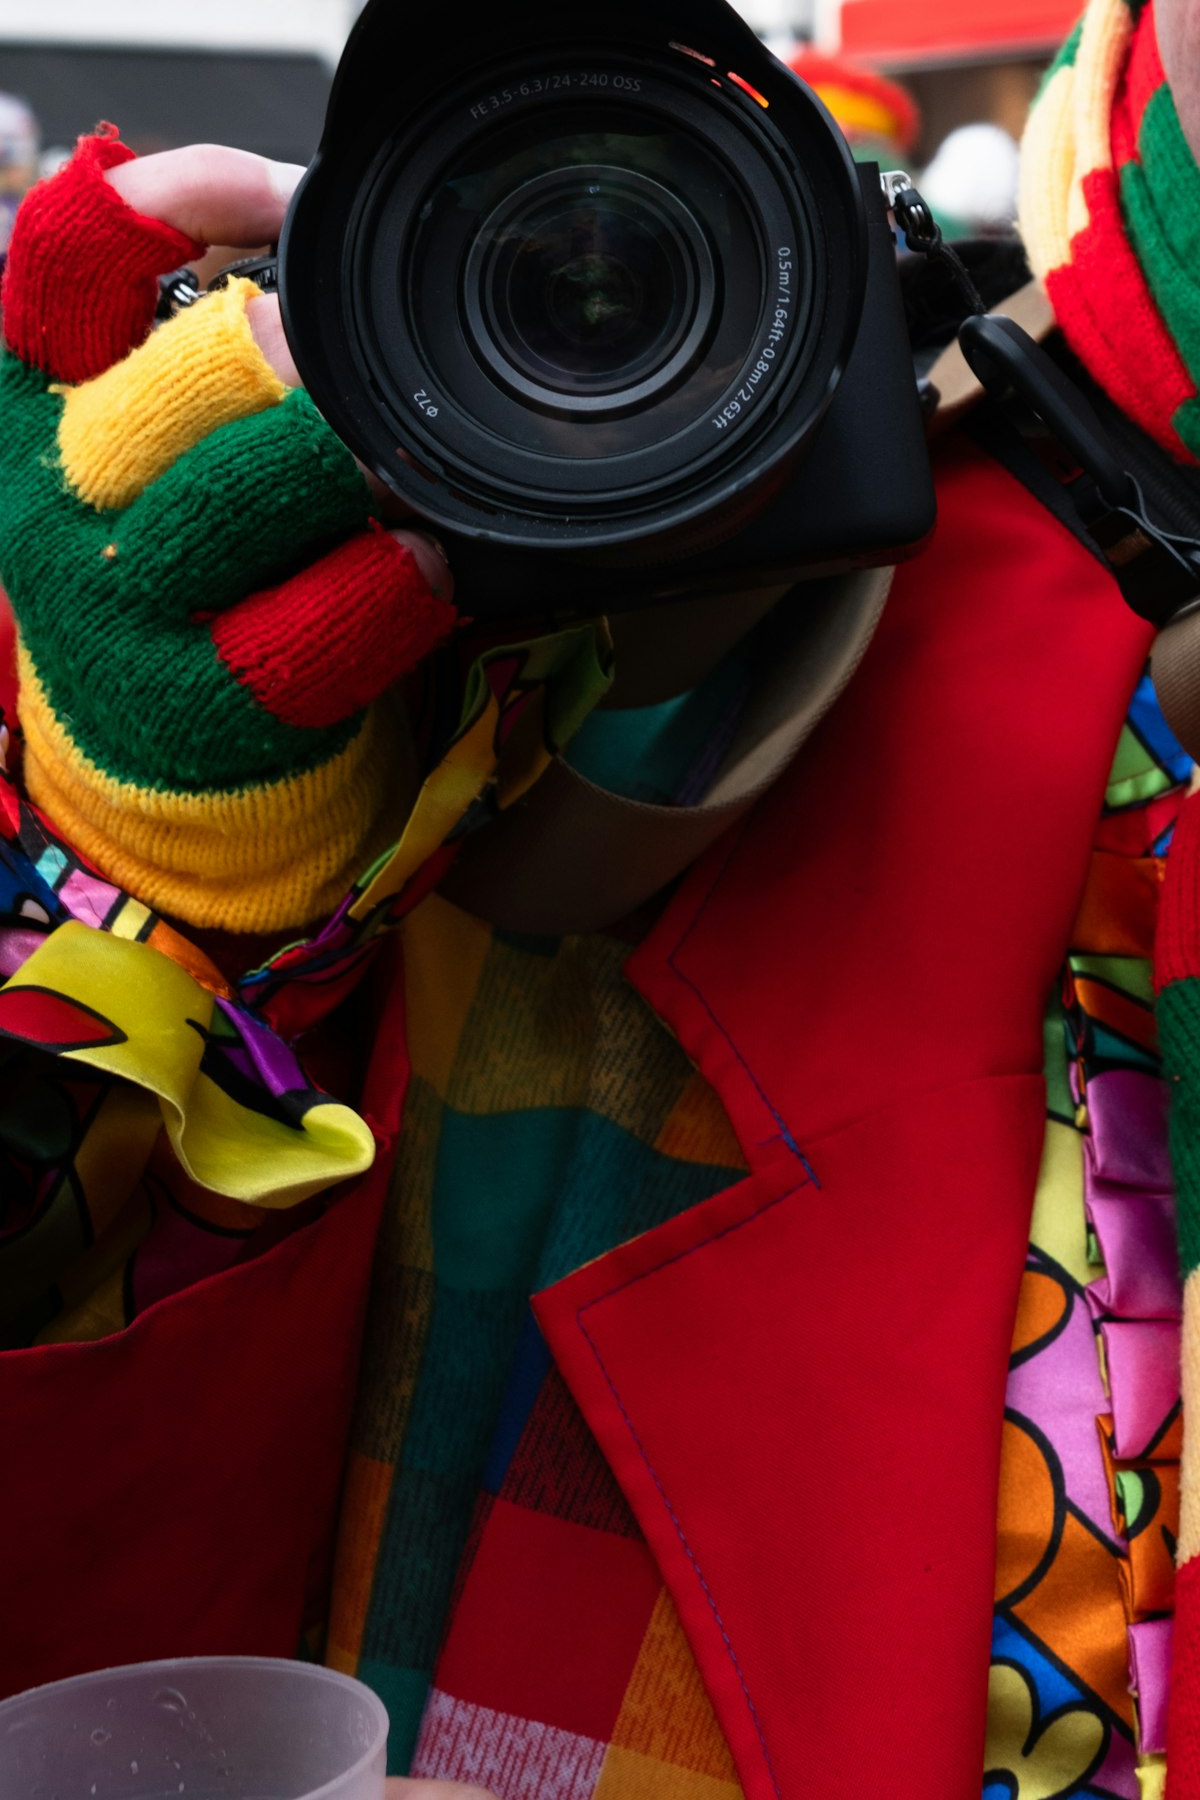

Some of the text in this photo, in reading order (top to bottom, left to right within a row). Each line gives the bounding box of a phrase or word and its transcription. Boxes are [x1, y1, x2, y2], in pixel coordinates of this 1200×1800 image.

[469, 73, 642, 119] FE 3.5-6.3/24-240 OSS
